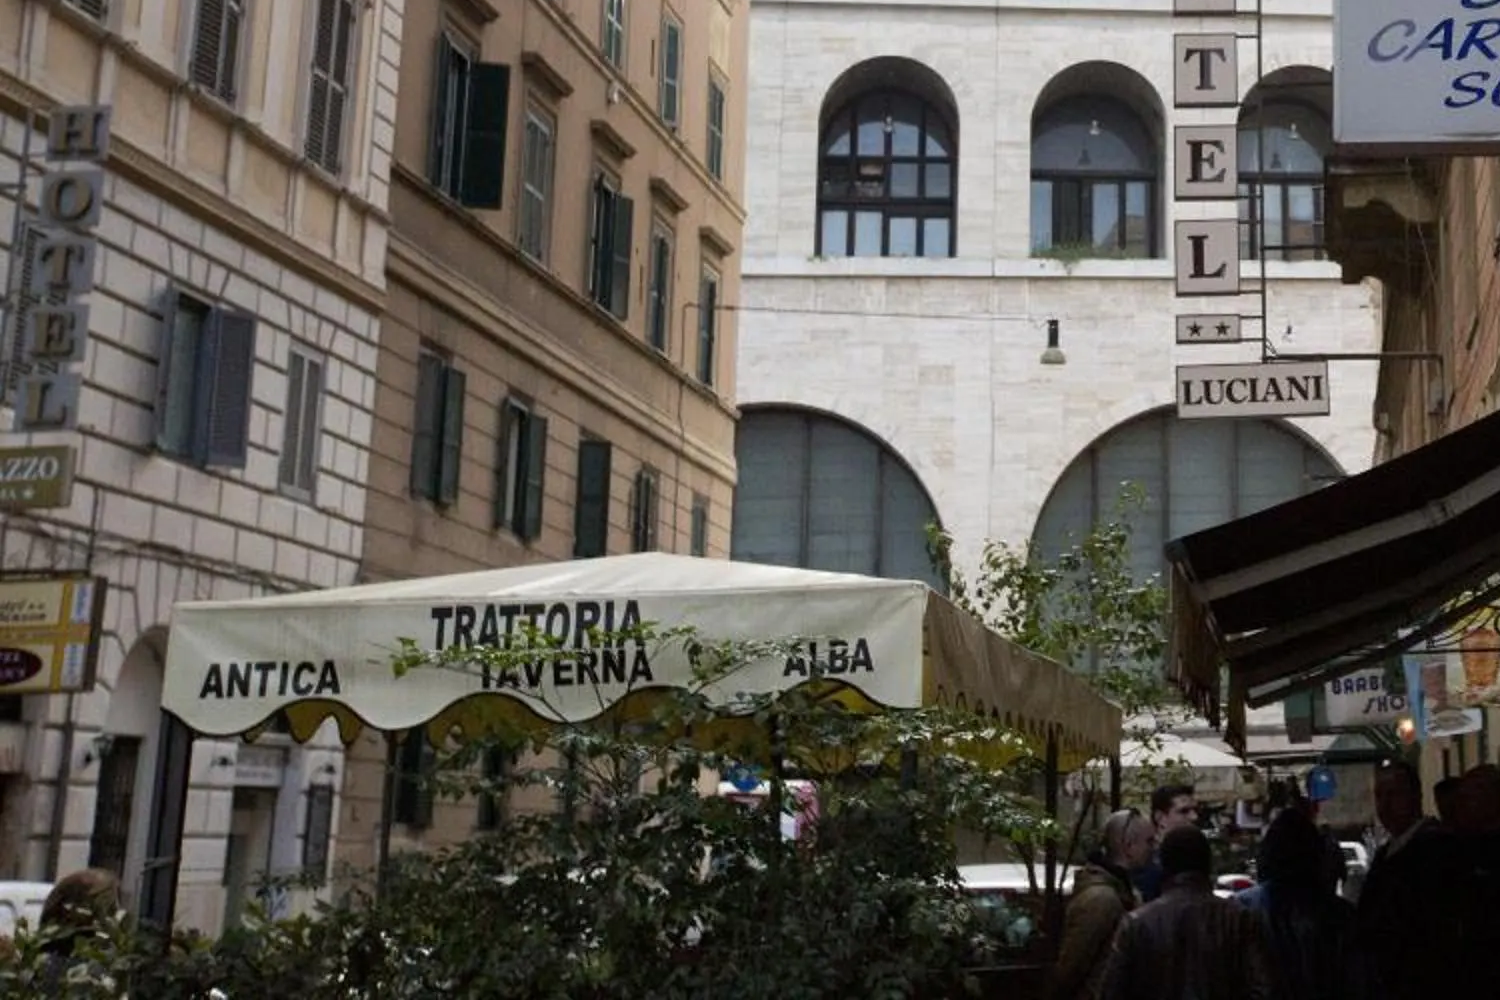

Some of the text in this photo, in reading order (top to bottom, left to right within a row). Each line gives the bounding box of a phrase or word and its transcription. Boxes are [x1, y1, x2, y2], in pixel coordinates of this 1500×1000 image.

[1182, 374, 1325, 405] LUCIANI
[431, 600, 646, 650] TRATTORIA
[199, 659, 341, 698] ANTICA
[1363, 695, 1411, 714] SHO
